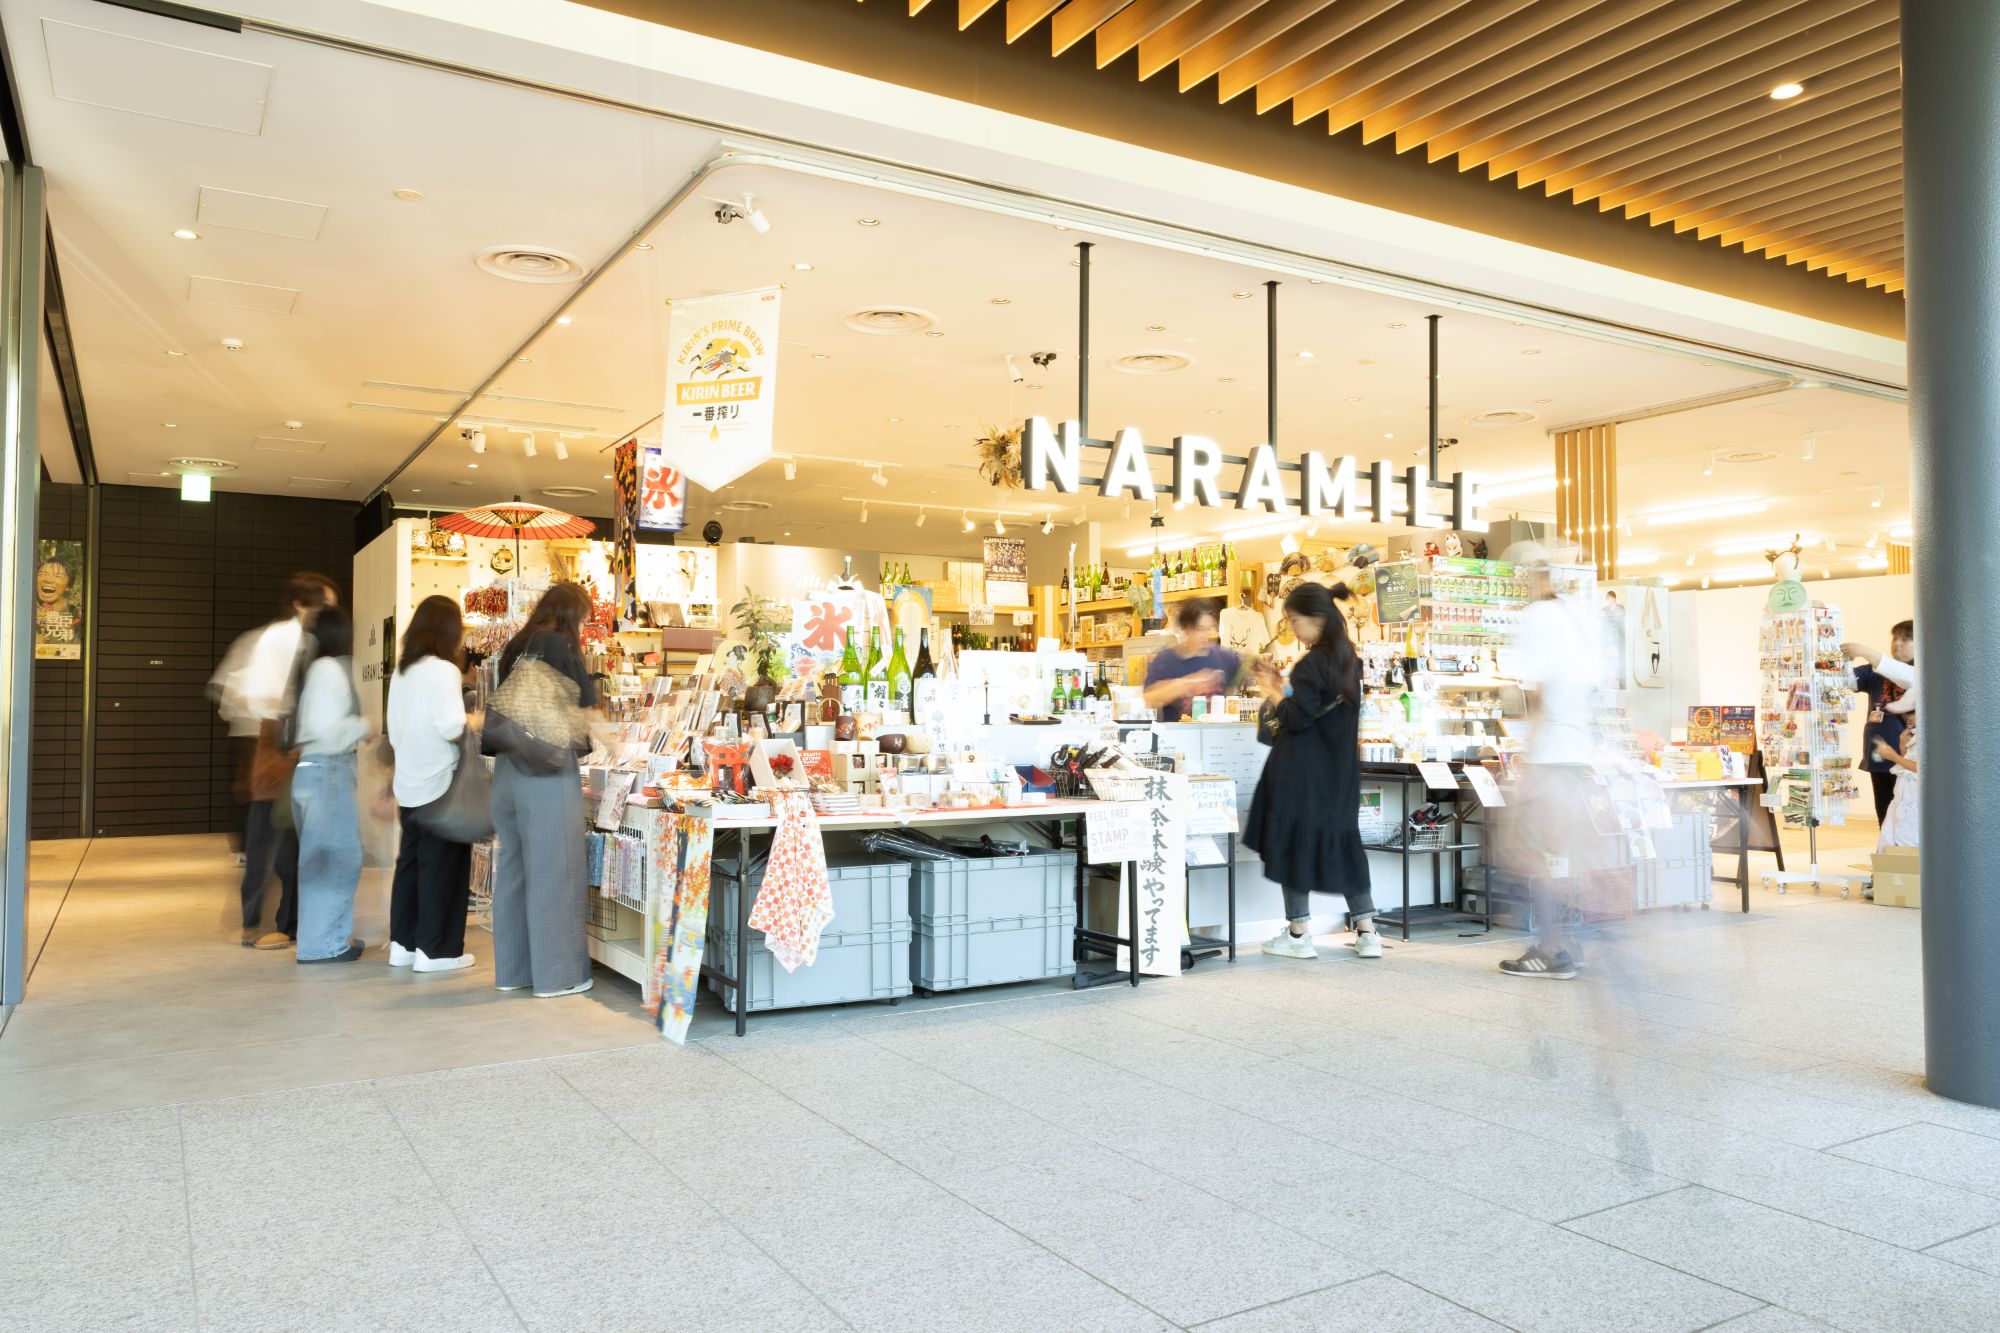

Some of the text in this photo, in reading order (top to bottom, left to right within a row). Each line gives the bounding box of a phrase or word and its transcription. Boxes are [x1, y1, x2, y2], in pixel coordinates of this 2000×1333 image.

[677, 319, 766, 365] KIRIN'S PRIME BREW
[681, 381, 755, 401] KIRIN BEER
[692, 404, 739, 421] 一番搾り
[641, 466, 681, 510] 氷
[1025, 415, 1489, 534] NARAMILE
[802, 601, 853, 652] 氷
[1089, 808, 1129, 822] FEEL FREE
[1090, 828, 1129, 846] STAMP
